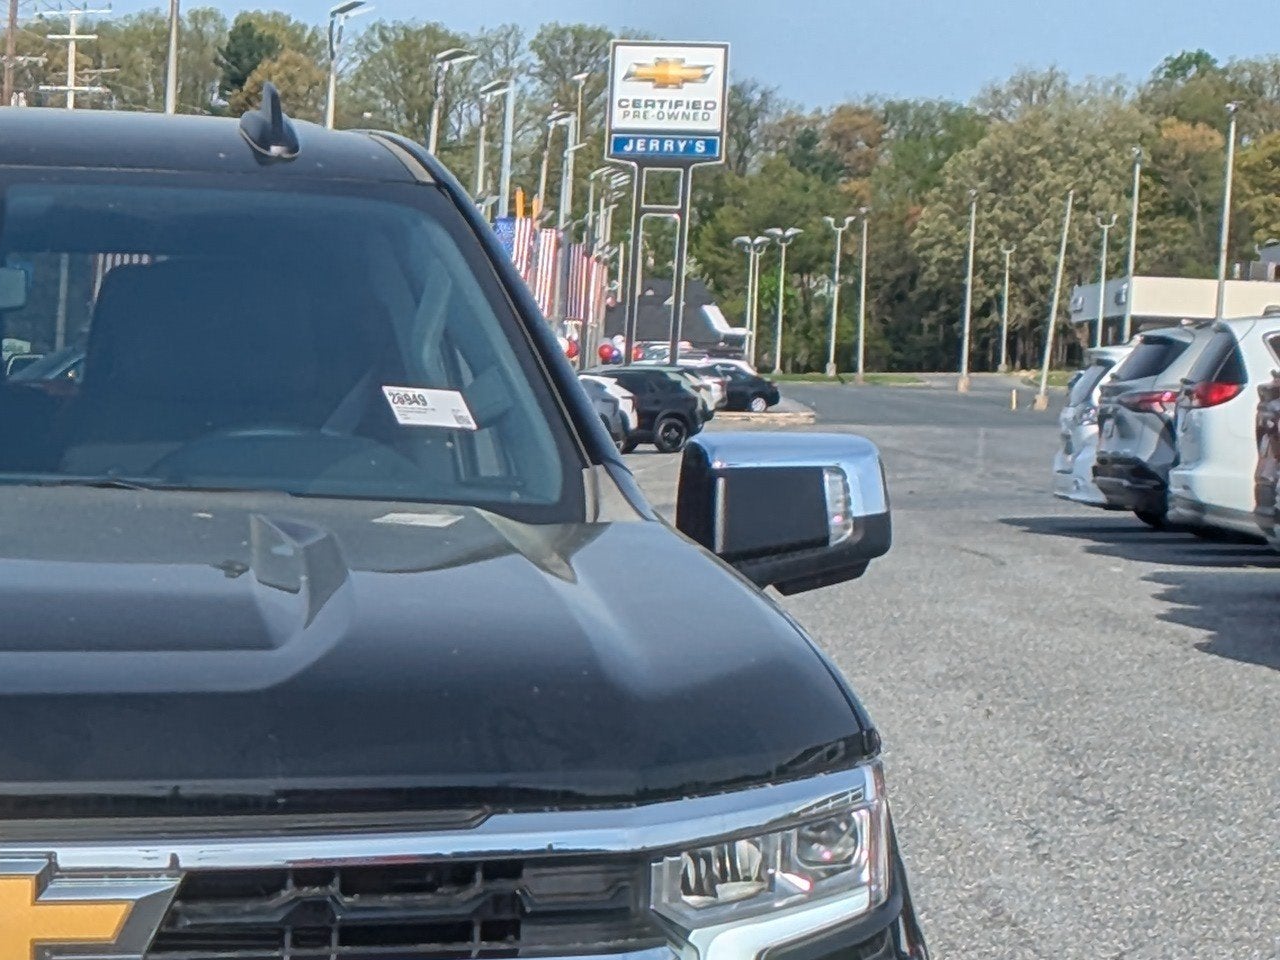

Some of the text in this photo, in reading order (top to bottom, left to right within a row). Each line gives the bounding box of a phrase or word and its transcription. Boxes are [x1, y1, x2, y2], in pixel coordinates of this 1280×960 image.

[618, 98, 717, 111] CERTIFIED
[622, 109, 711, 122] PRE-OWNED
[623, 138, 706, 153] JERRY'S
